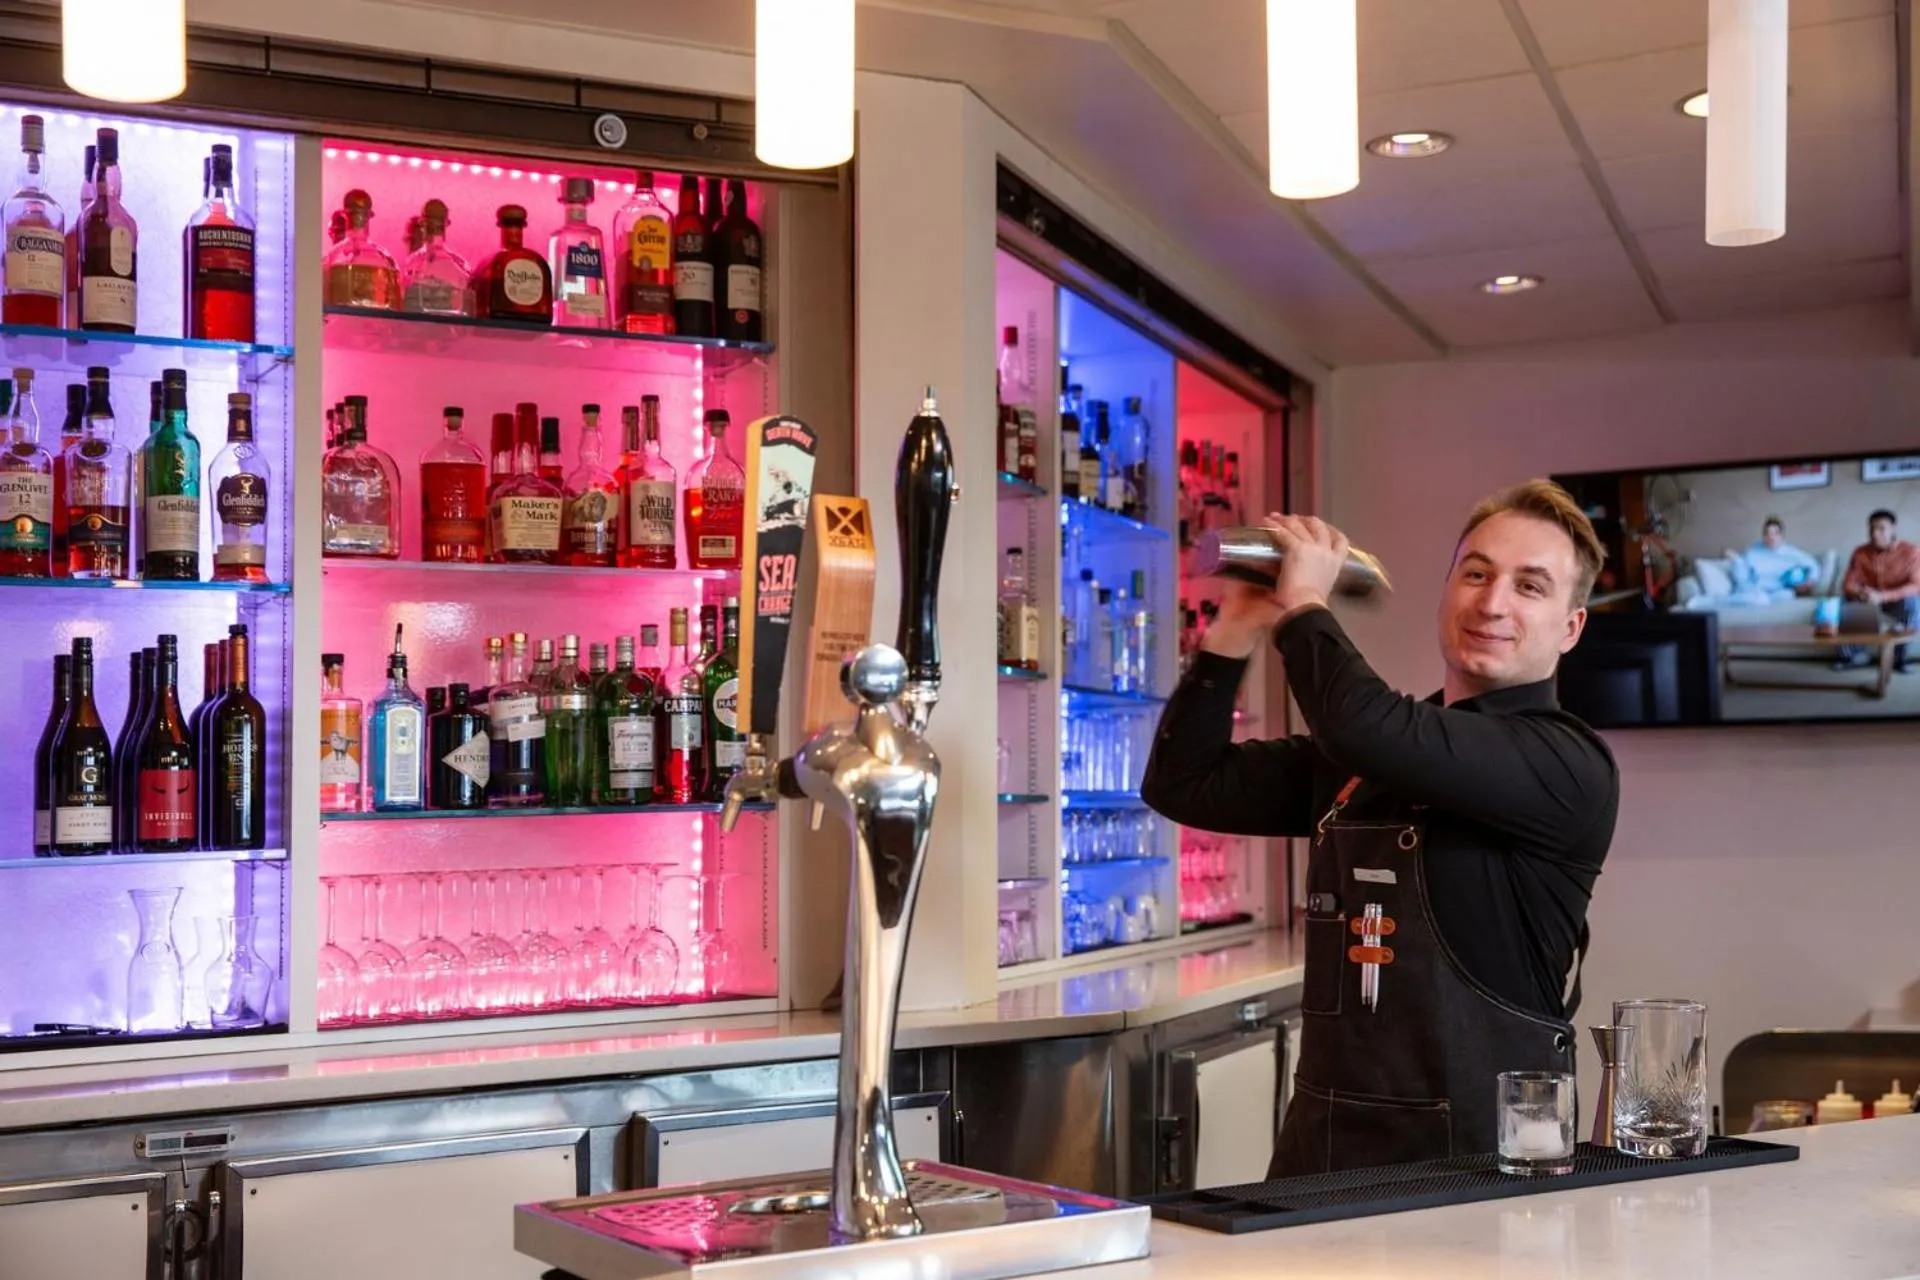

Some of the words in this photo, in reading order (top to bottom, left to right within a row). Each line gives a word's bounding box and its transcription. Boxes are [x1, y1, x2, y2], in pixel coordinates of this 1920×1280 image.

[571, 253, 598, 265] 1800
[18, 476, 32, 484] THE
[0, 481, 48, 496] GLENLIVET
[18, 494, 31, 504] 12
[511, 499, 559, 510] Maker's
[527, 510, 558, 521] Mark
[758, 554, 797, 592] SEA
[81, 766, 98, 783] G
